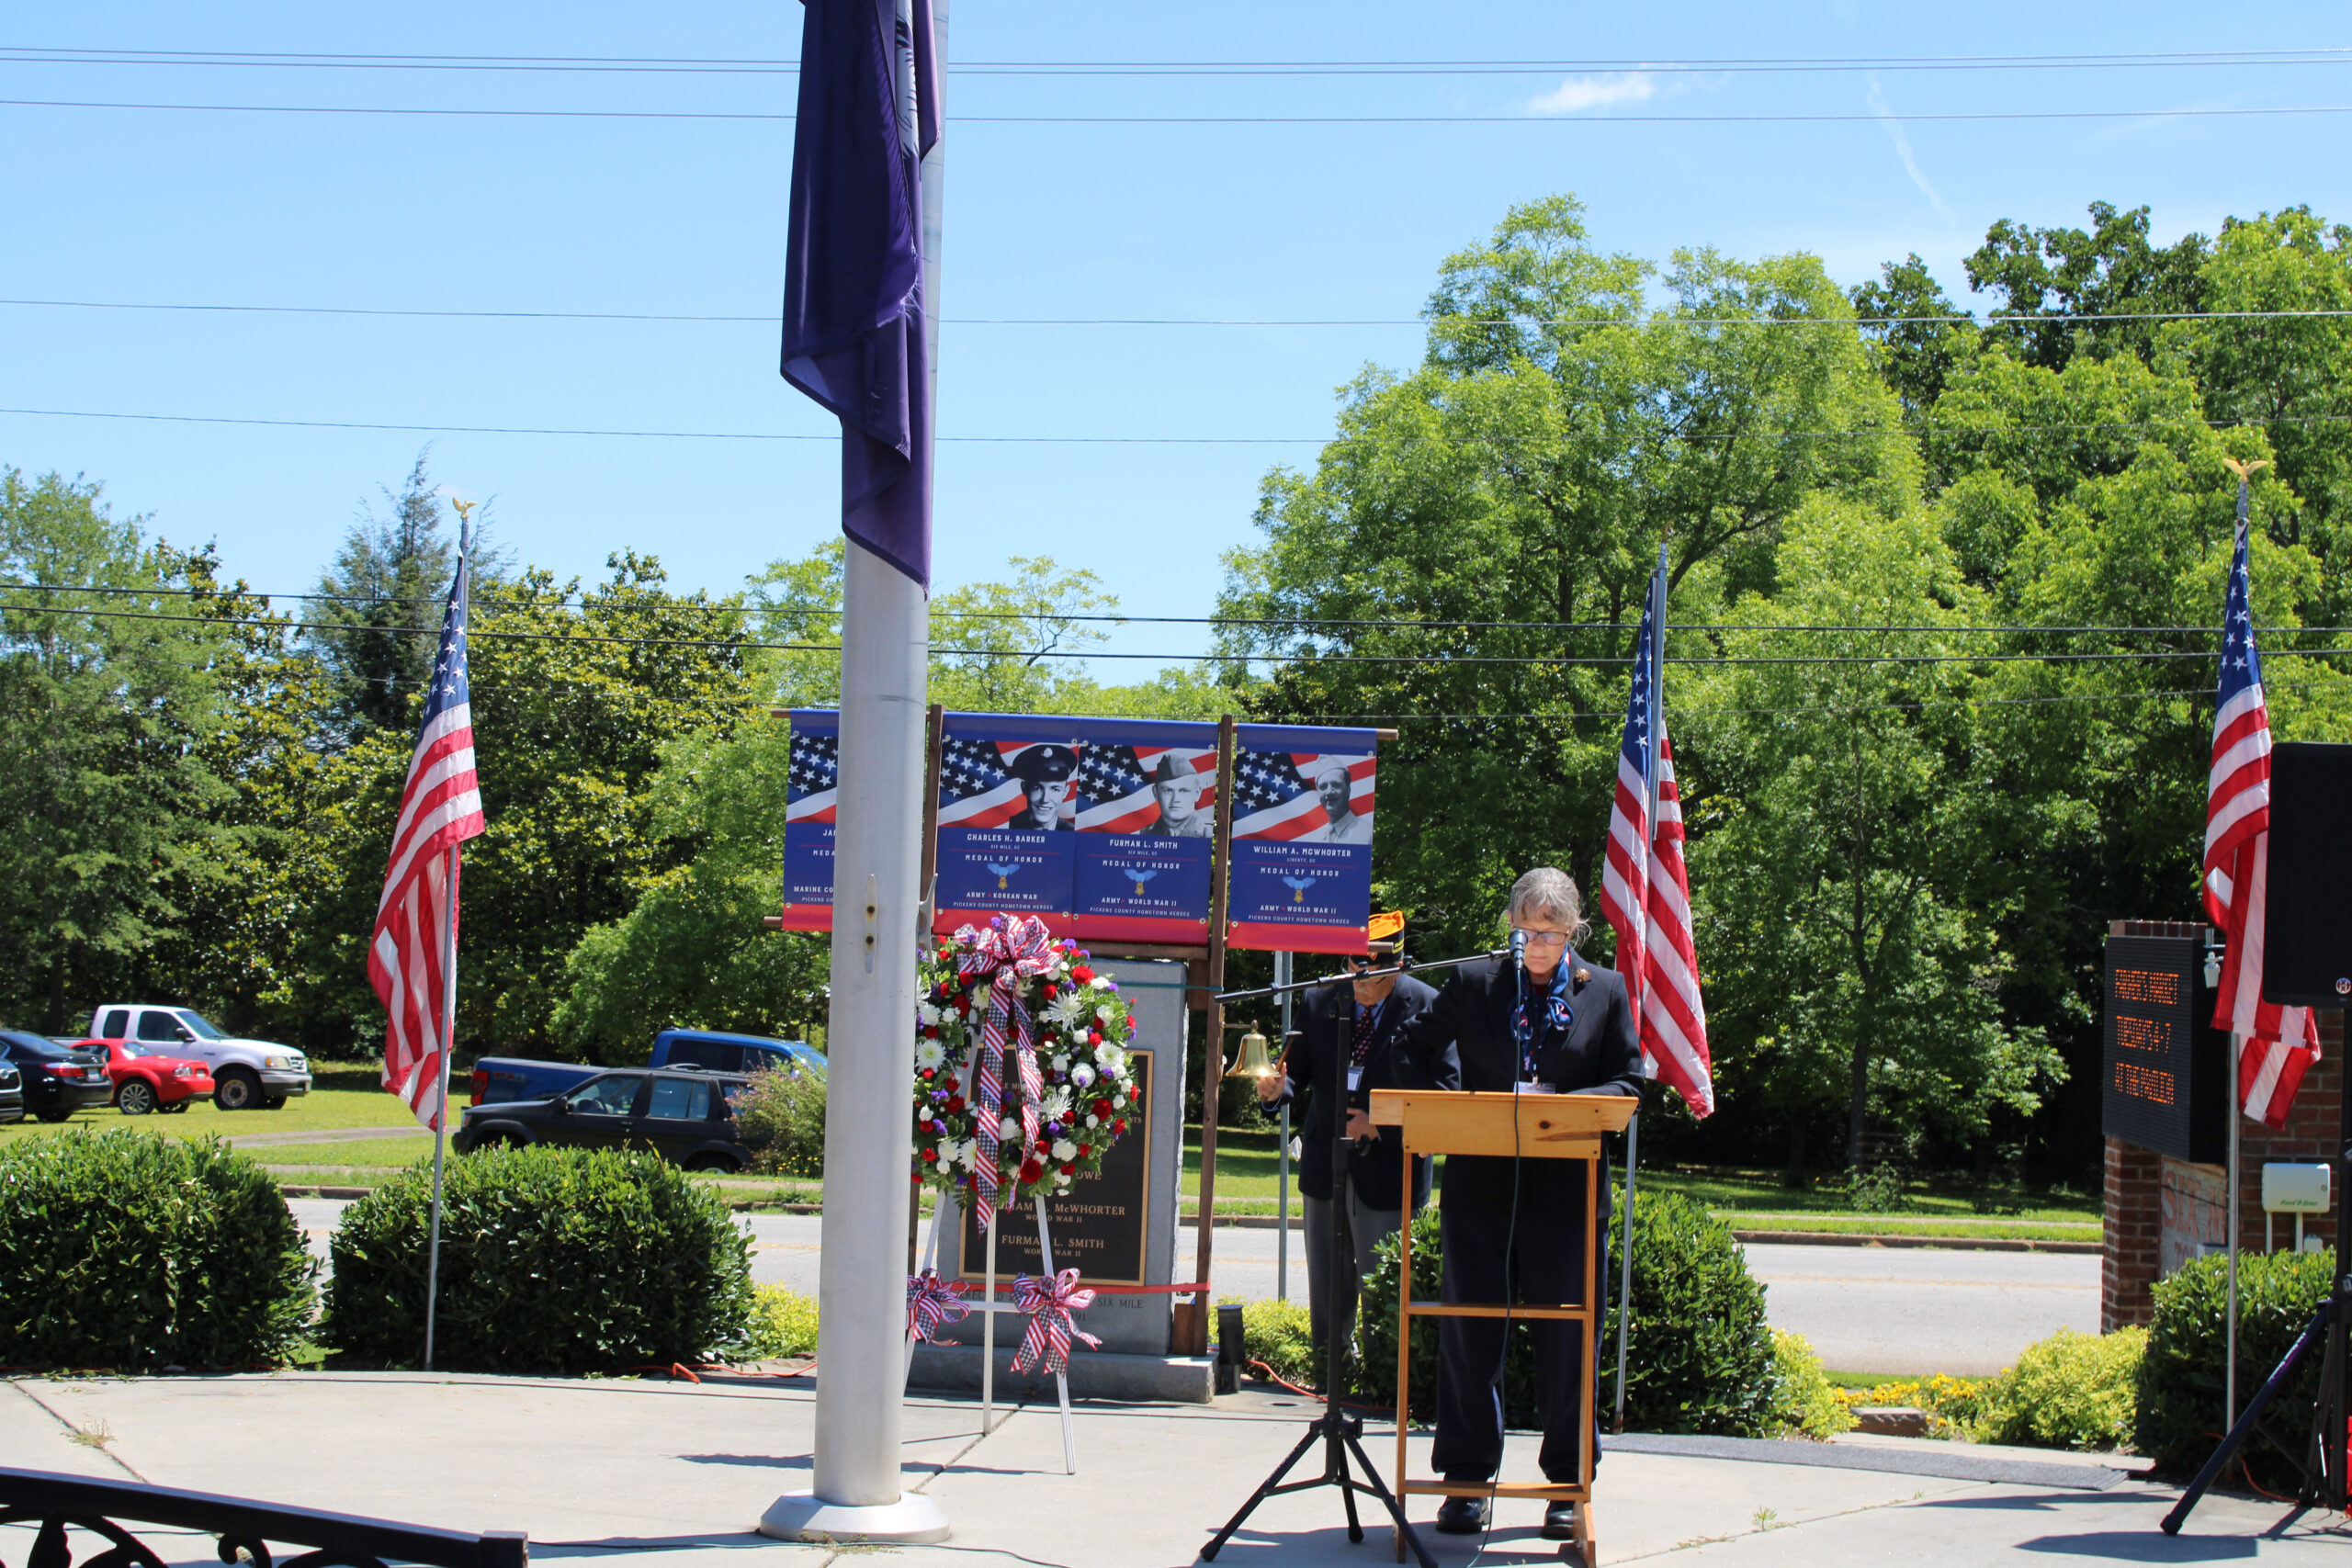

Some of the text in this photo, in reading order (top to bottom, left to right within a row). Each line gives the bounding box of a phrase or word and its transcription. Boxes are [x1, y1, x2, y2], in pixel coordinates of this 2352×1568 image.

[967, 833, 1046, 844] CHARLES H. BARKER
[1109, 839, 1141, 848] FURMAN
[1154, 840, 1178, 850] SMITH
[1253, 845, 1351, 857] WILLIAM A. MCWHORTER
[1151, 862, 1180, 870] HONOR
[1310, 869, 1340, 877] HONOR
[1128, 897, 1151, 906] WORLD
[1075, 1169, 1102, 1181] OWE
[1054, 1202, 1126, 1216] McWHORTER
[2162, 1169, 2200, 1239] SIX
[1025, 1213, 1083, 1224] WOD WAR II
[1001, 1234, 1105, 1250] FURMA L. SMITH
[1054, 1249, 1073, 1258] WAR
[1097, 1296, 1114, 1309] SIX
[1119, 1298, 1144, 1310] MILE
